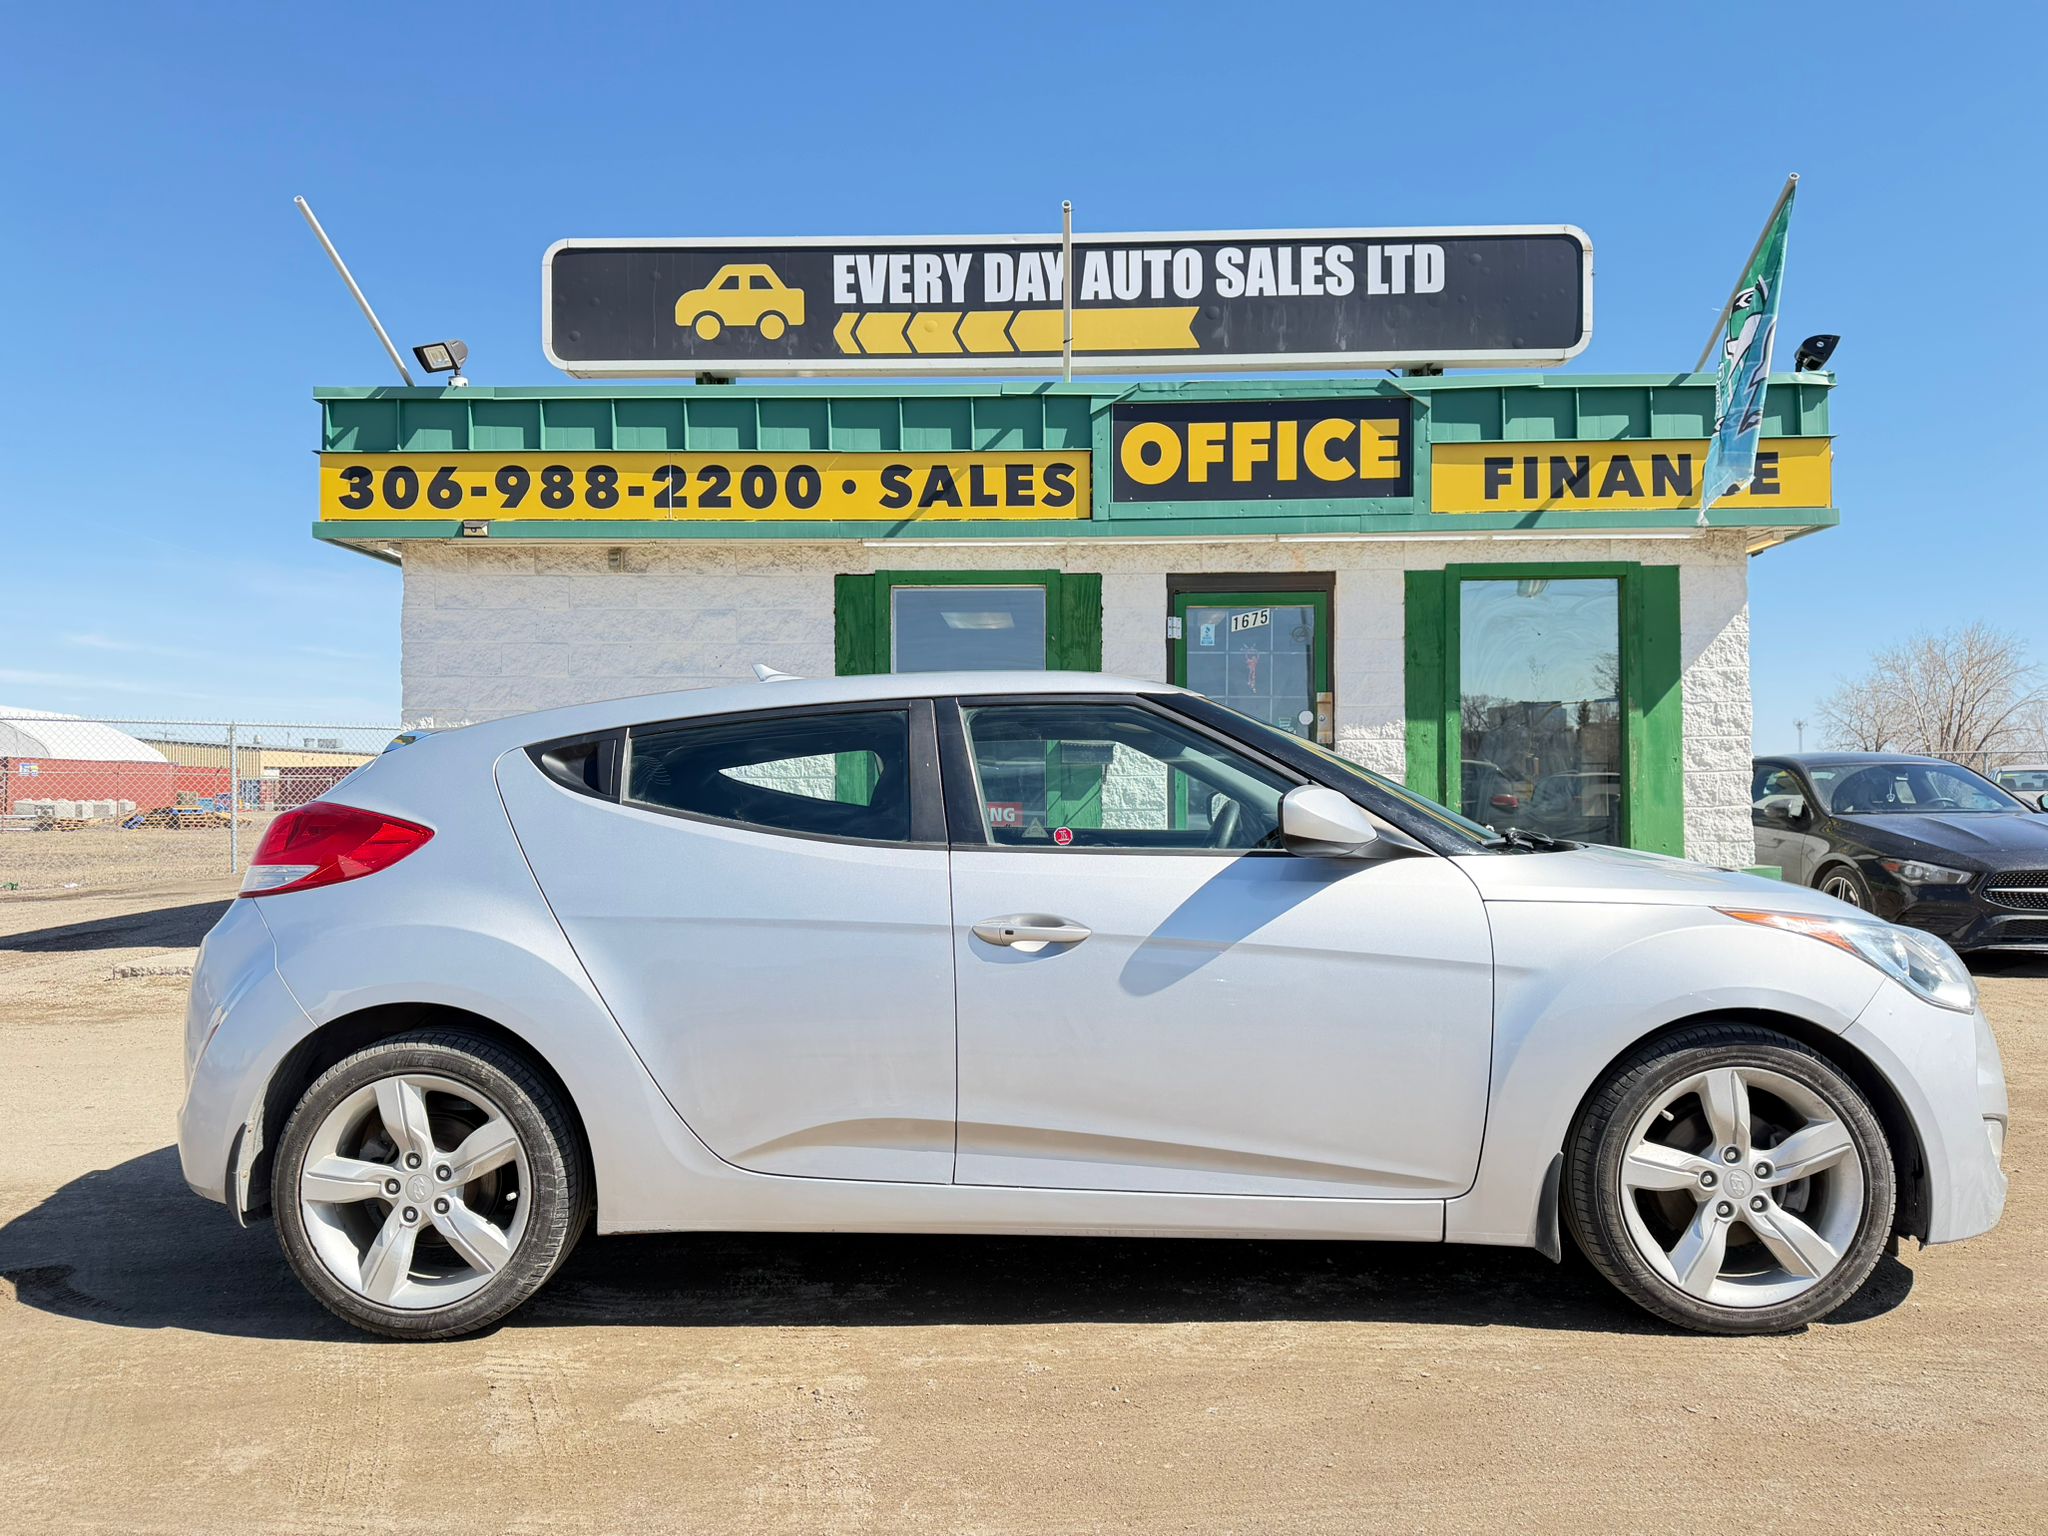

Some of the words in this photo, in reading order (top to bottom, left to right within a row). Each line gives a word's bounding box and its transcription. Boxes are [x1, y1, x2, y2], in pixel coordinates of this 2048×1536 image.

[833, 253, 973, 304] EVERY
[983, 251, 1065, 303] DAY
[1080, 248, 1203, 300] AUTO
[1215, 245, 1355, 298] SALES
[1367, 244, 1445, 295] LTD
[1120, 417, 1401, 485] OFFICE
[338, 464, 822, 510] 306-988-2200
[878, 463, 1077, 509] SALES
[1484, 452, 1781, 500] FINANE
[1233, 609, 1268, 631] 1675
